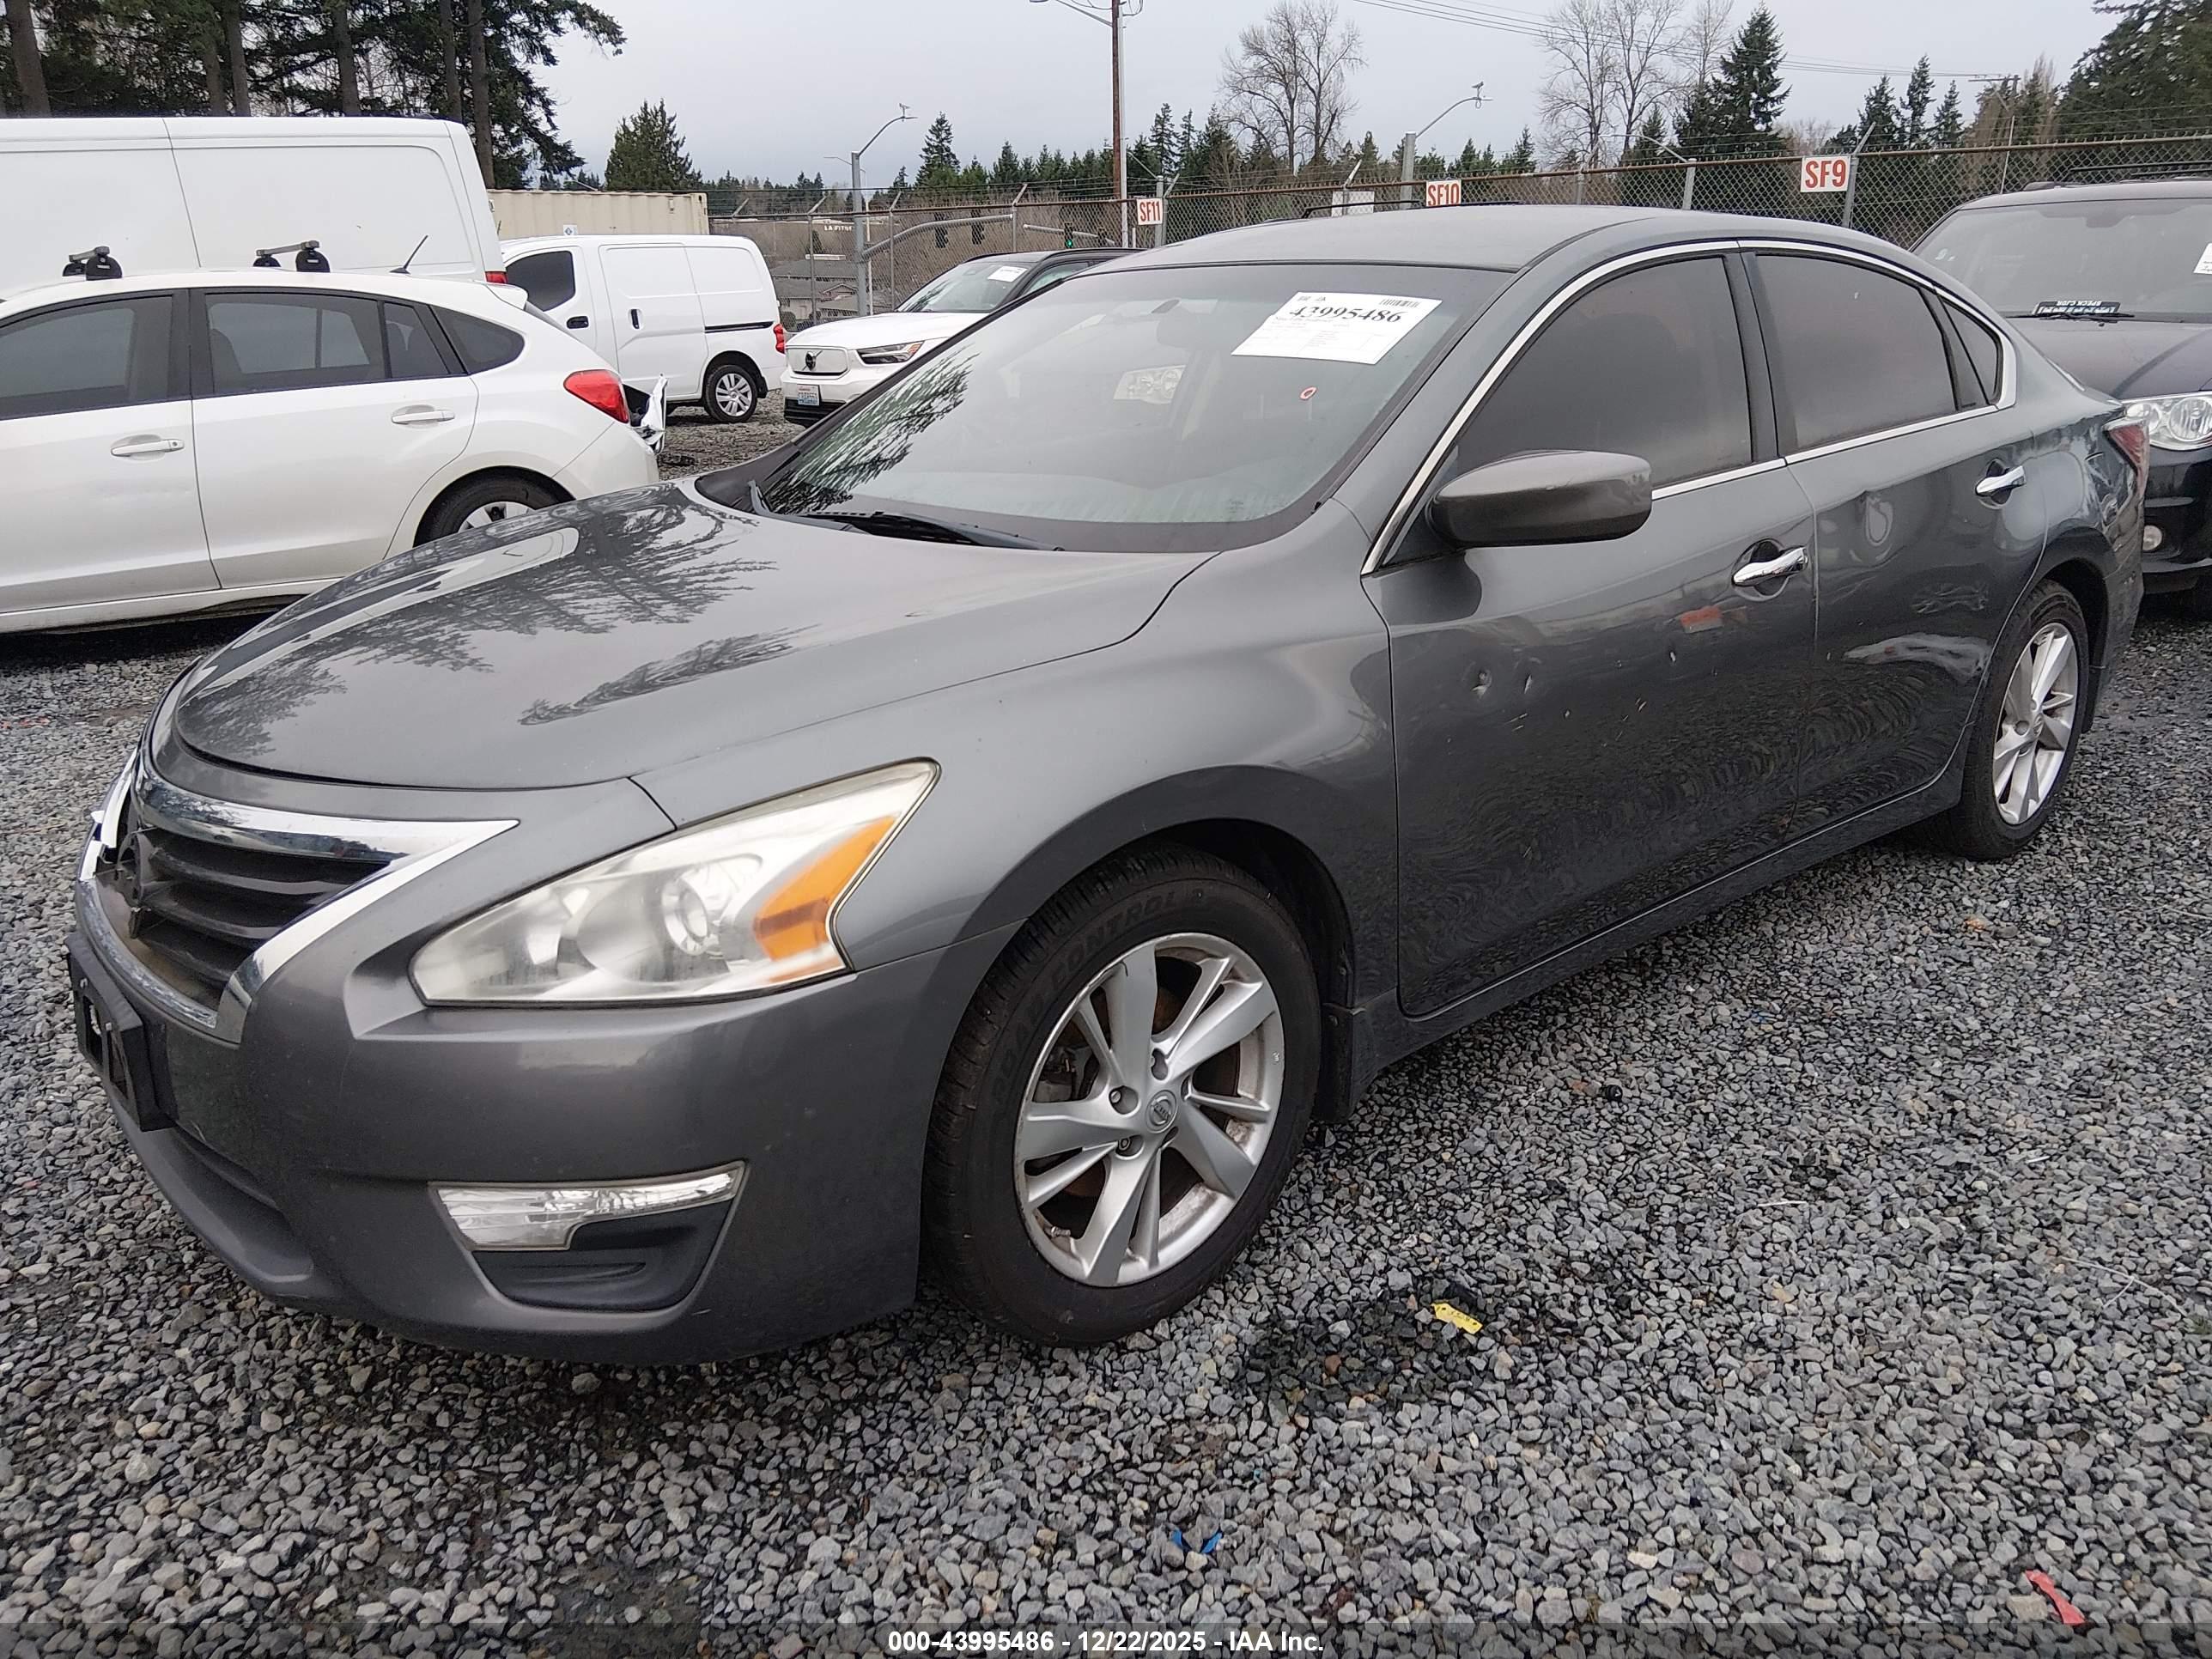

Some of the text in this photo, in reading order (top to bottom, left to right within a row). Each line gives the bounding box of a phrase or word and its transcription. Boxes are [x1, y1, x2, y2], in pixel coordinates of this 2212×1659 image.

[1805, 159, 1846, 189] SF9
[1427, 183, 1460, 206] SF10
[1139, 200, 1161, 222] SF11
[1289, 305, 1408, 323] 43995486
[1051, 890, 1177, 991] CONTROL
